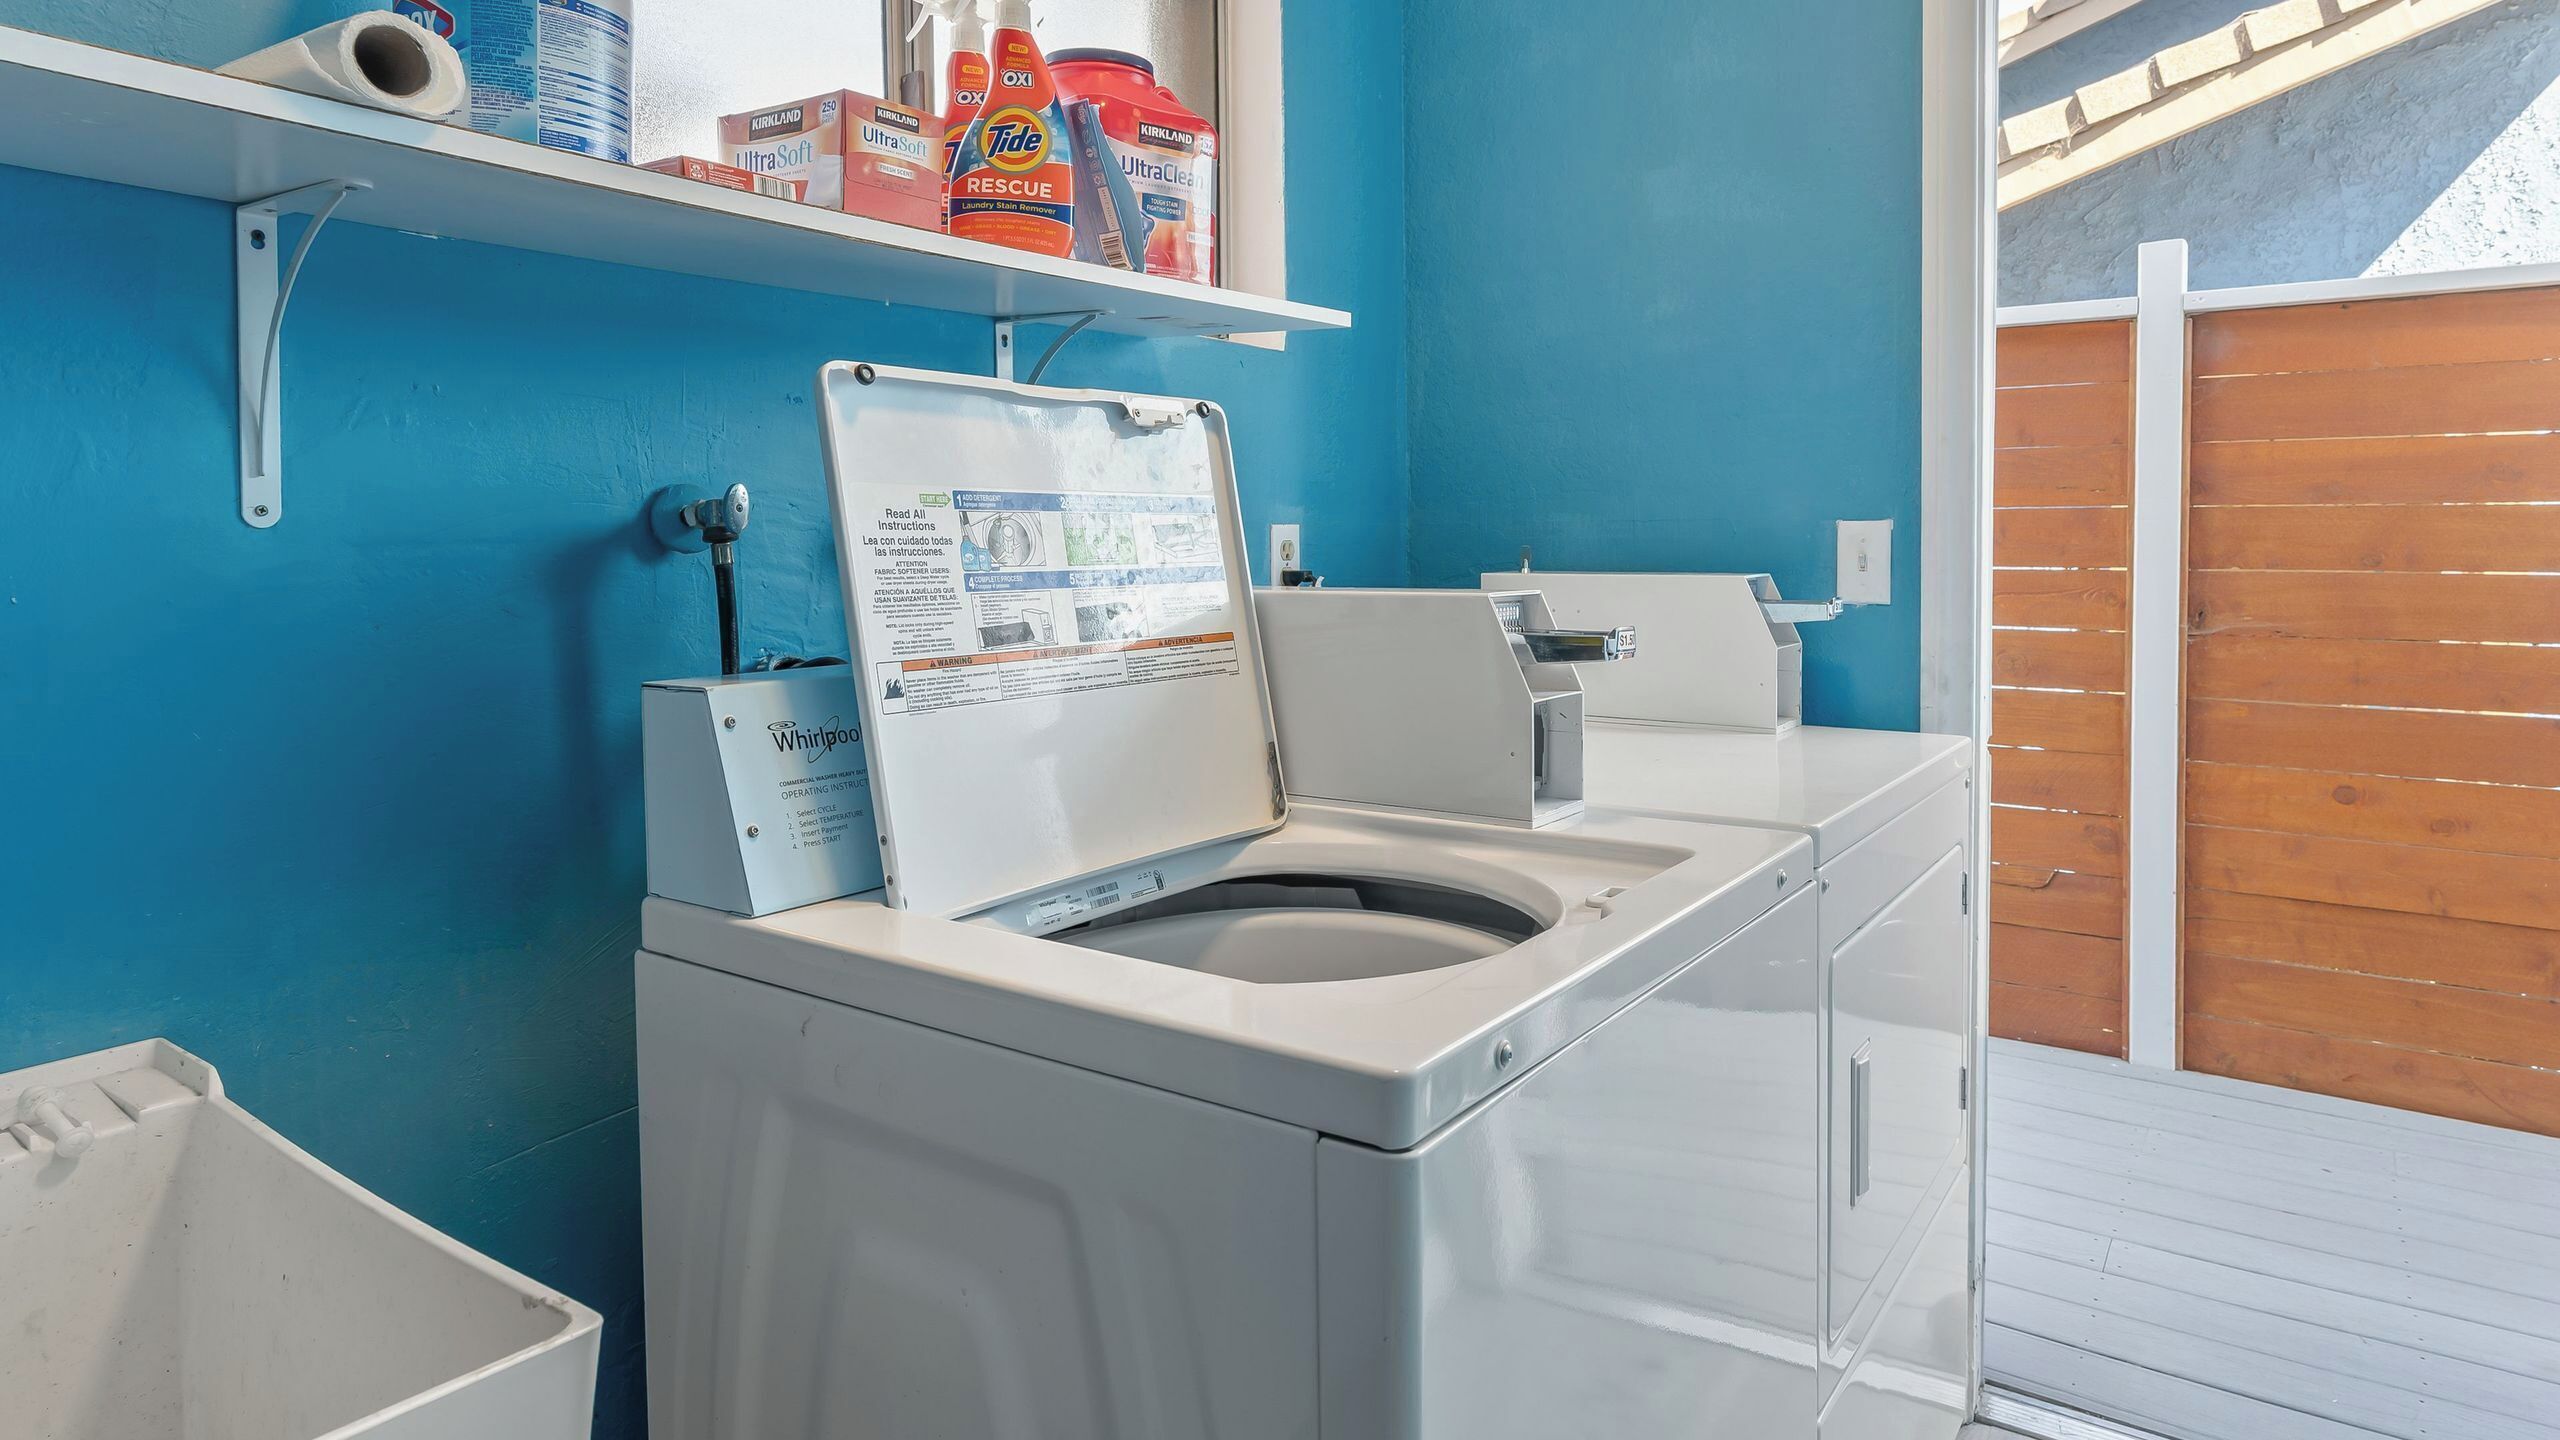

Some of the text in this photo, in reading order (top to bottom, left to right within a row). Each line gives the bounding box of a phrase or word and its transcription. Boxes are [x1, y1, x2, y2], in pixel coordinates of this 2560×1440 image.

[1002, 70, 1034, 87] OXI
[822, 100, 836, 113] 250
[752, 110, 801, 130] KIRKLAND
[877, 108, 918, 127] KIRKLAND
[864, 125, 928, 157] UltraSoft
[986, 122, 1043, 160] Tide
[1141, 124, 1192, 144] KIRKLAND
[736, 140, 813, 172] UltraSoft
[880, 164, 913, 177] FRESH SCENT
[1122, 155, 1203, 189] UltraClean
[967, 178, 1052, 198] RESCUE
[962, 201, 1056, 215] Laundry Stain Remover
[1151, 198, 1166, 206] TOUGH
[1147, 205, 1181, 216] FIGHTING POWER
[957, 494, 962, 506] 1
[886, 509, 925, 519] Read All
[878, 520, 935, 530] Instructions
[863, 536, 953, 545] Lea con cuidado todas
[875, 547, 945, 556] las instrucciones.
[969, 576, 975, 589] 4
[1070, 574, 1076, 584] 5
[1164, 637, 1202, 646] ADVERTENCIA
[937, 657, 973, 666] WARNING
[772, 722, 862, 752] Whirlpool
[779, 777, 814, 787] COMMERCIAL
[815, 773, 837, 782] WASHER
[781, 778, 869, 800] OPERATING INSTRUCT
[797, 808, 816, 818] Select
[817, 804, 837, 814] CYCLE
[799, 819, 818, 828] Select
[820, 809, 864, 823] TEMPERATURE
[801, 830, 820, 838] Insert
[821, 823, 848, 835] Payment
[804, 839, 821, 848] Press
[822, 834, 841, 844] START
